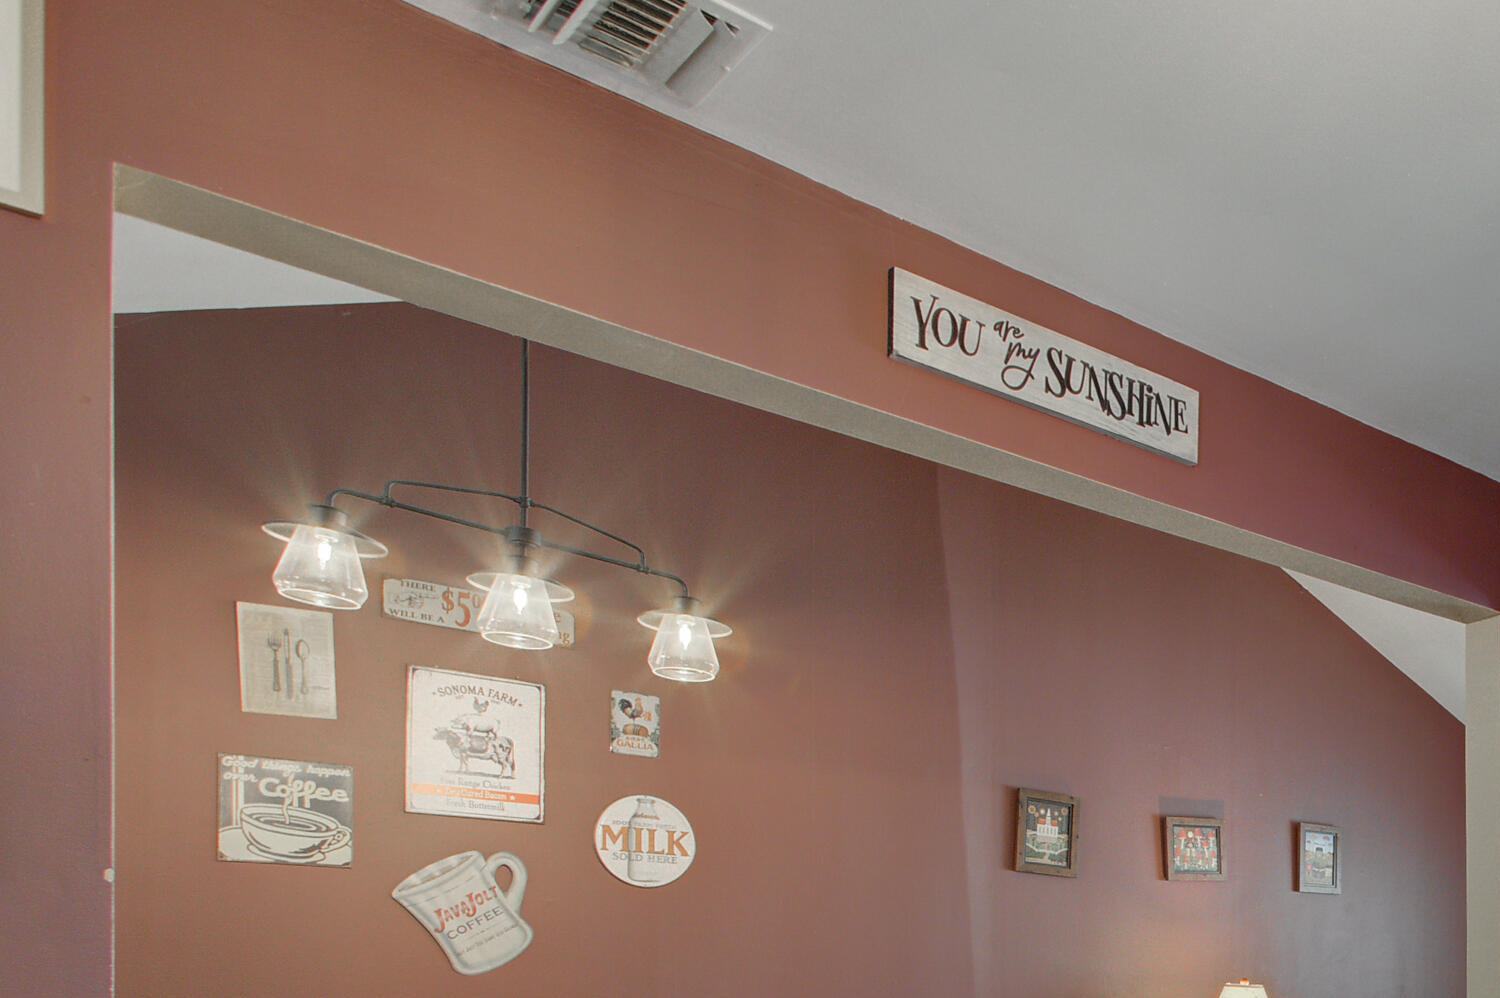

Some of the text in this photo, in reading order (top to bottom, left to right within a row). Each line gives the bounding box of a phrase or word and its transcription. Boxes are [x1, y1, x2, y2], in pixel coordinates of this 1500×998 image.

[910, 294, 986, 356] YOU
[993, 320, 1025, 342] are
[1001, 342, 1040, 391] my
[437, 684, 519, 707] SONOMA FARM
[221, 755, 351, 778] Good things happen
[222, 772, 349, 809] over Coffee
[600, 825, 690, 857] MILK
[612, 852, 678, 865] SOLD HERE
[447, 906, 504, 939] COFFEE
